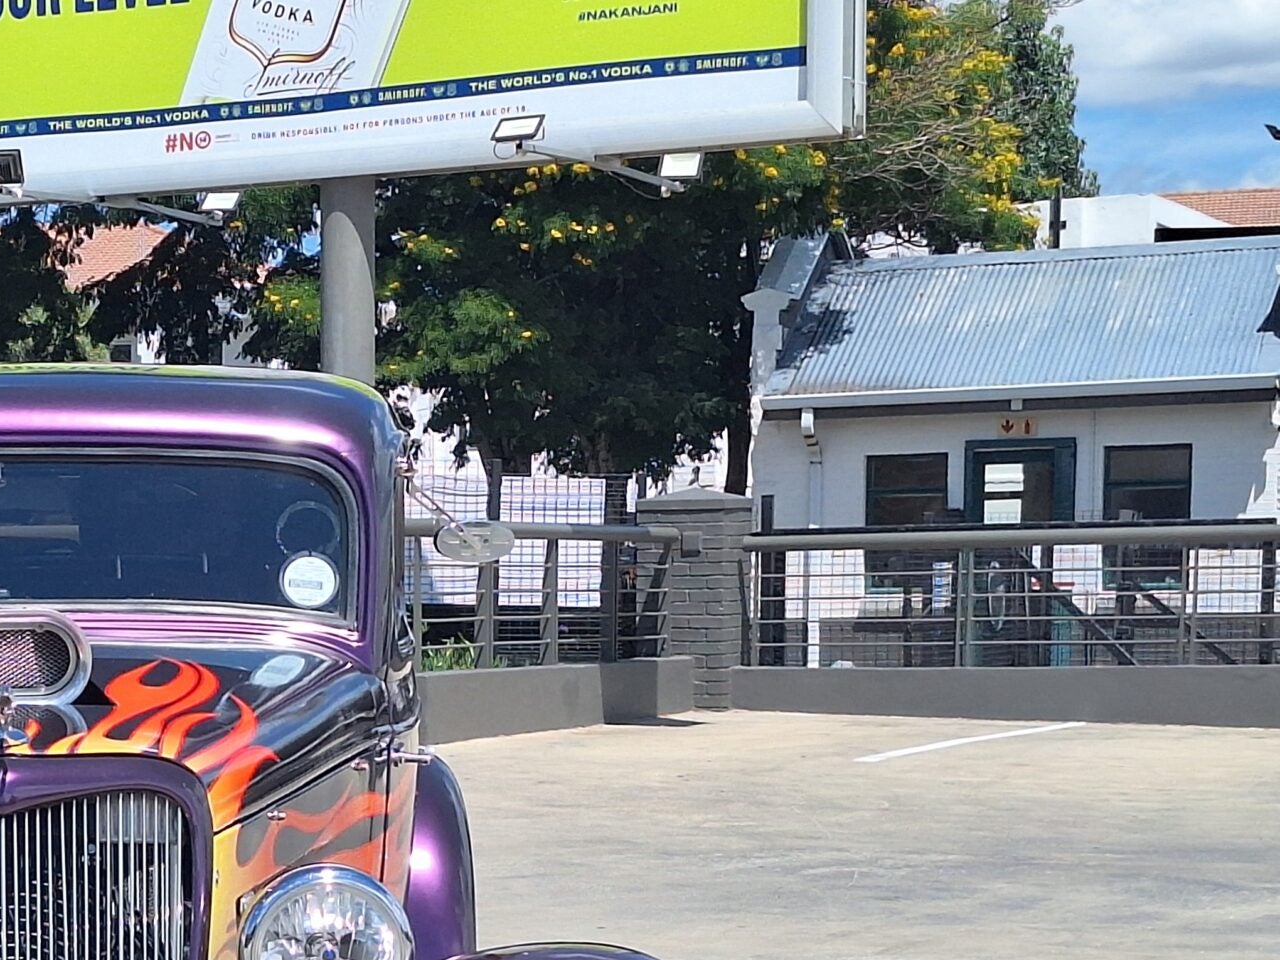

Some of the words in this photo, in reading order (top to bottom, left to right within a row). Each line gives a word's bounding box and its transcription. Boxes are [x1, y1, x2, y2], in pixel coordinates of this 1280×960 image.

[251, 0, 314, 23] VODKA
[578, 3, 678, 22] #NAKANJANI
[469, 80, 497, 92] THE
[500, 73, 565, 88] WORLD'S
[601, 64, 652, 78] VODKA
[48, 121, 73, 131] THE
[75, 117, 132, 129] WORLD'S
[165, 109, 210, 122] VODKA
